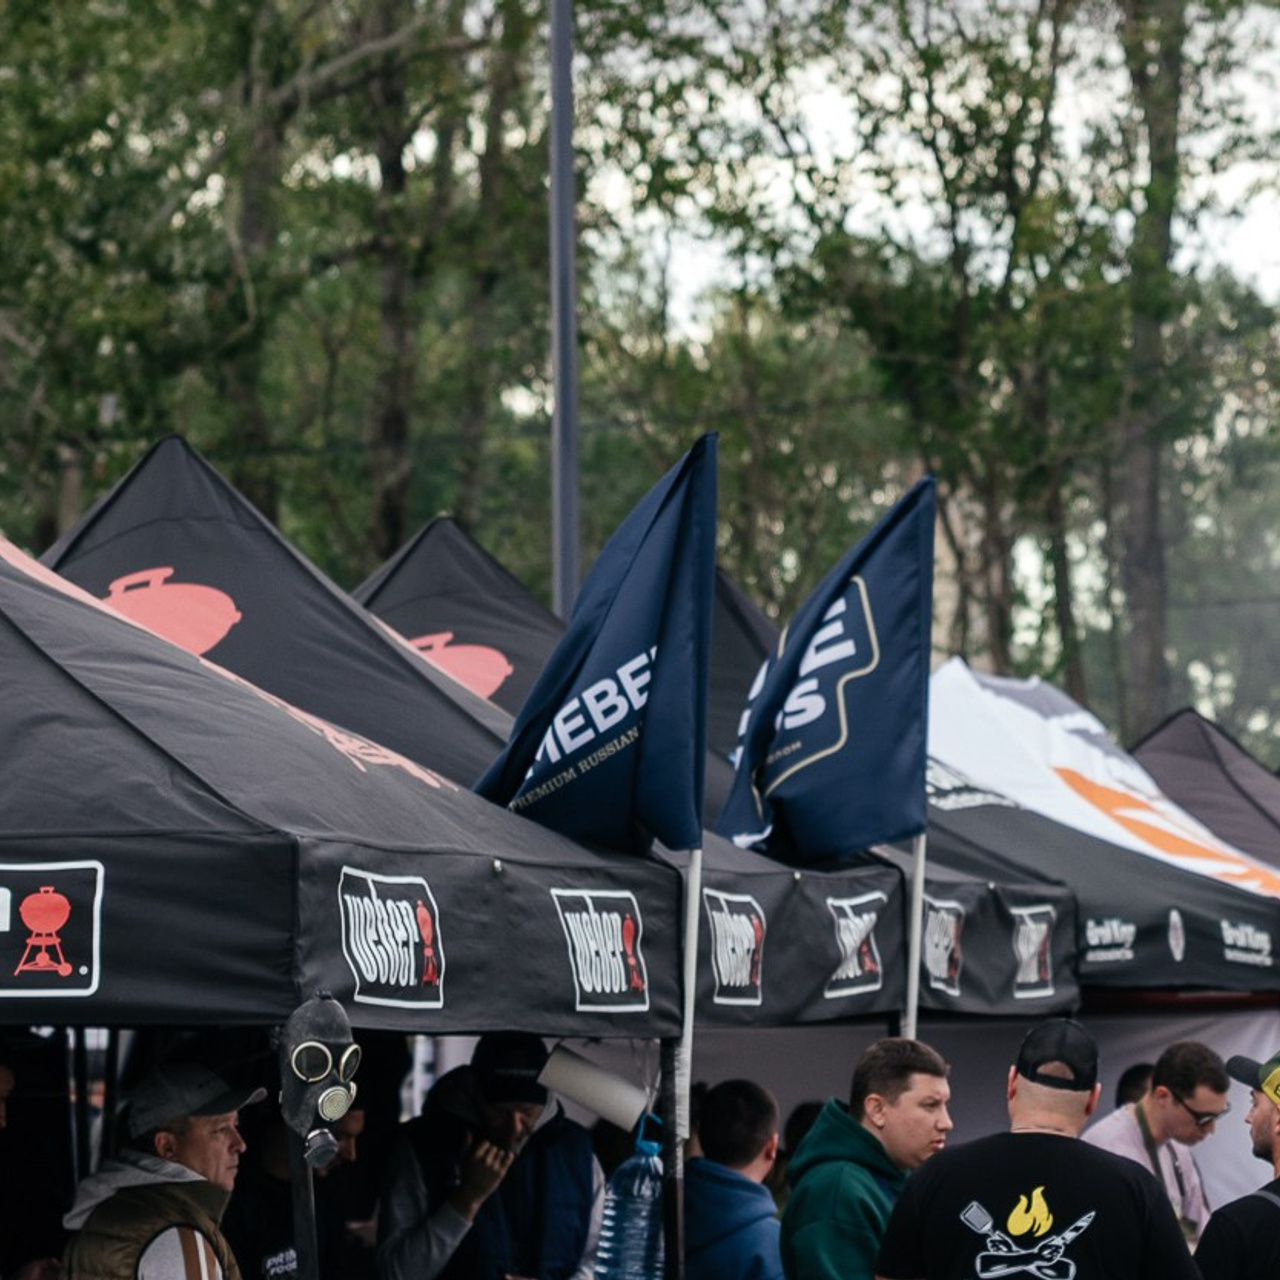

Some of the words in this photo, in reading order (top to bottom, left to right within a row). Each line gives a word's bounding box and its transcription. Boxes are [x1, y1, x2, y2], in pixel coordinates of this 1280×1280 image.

[578, 727, 640, 774] RUSSIAN
[343, 878, 420, 987] weber
[564, 895, 628, 994] weber
